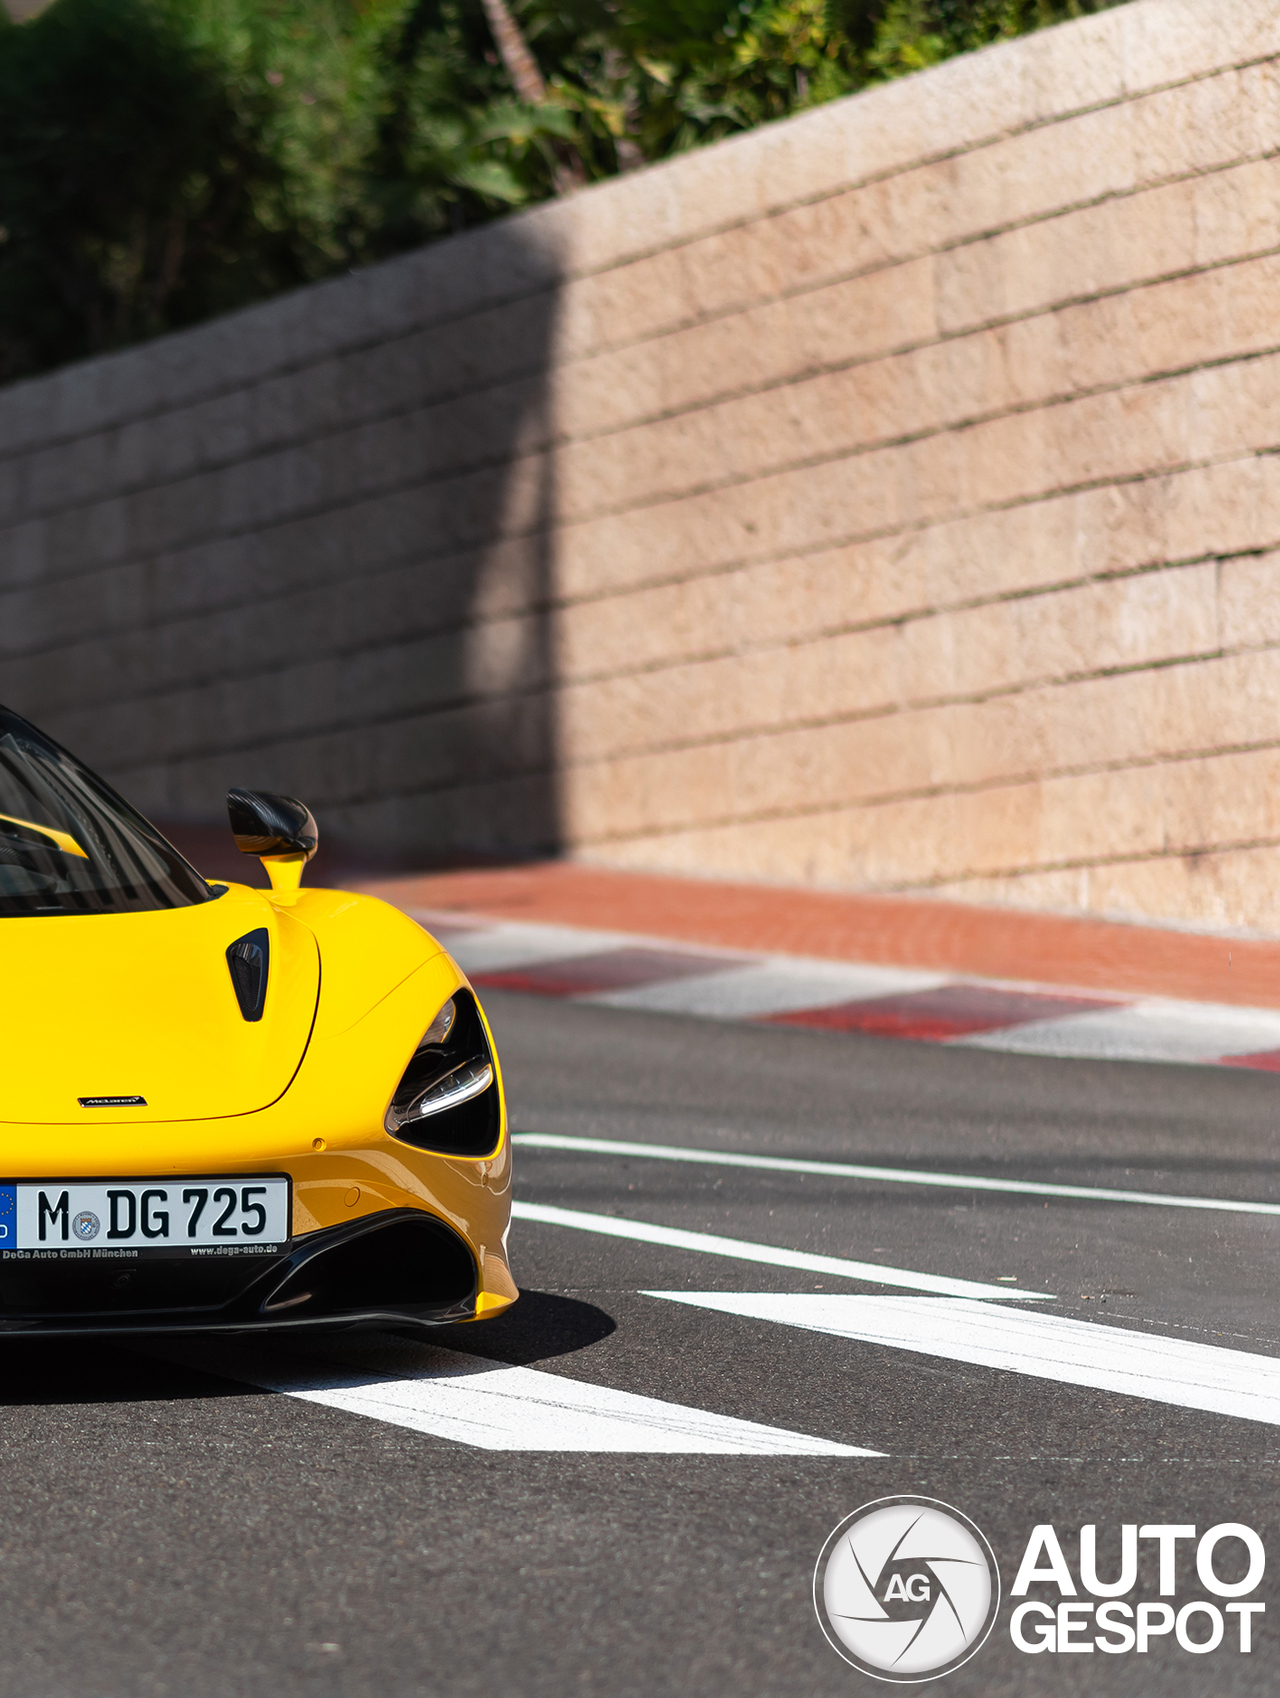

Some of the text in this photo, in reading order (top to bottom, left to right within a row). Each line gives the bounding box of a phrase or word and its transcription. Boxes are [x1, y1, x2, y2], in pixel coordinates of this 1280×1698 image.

[38, 1190, 69, 1241] M
[106, 1188, 170, 1238] DG
[182, 1186, 267, 1237] 725
[2, 1248, 138, 1259] DeGa Auto GmbH München
[190, 1244, 278, 1256] www.dega-auto.de
